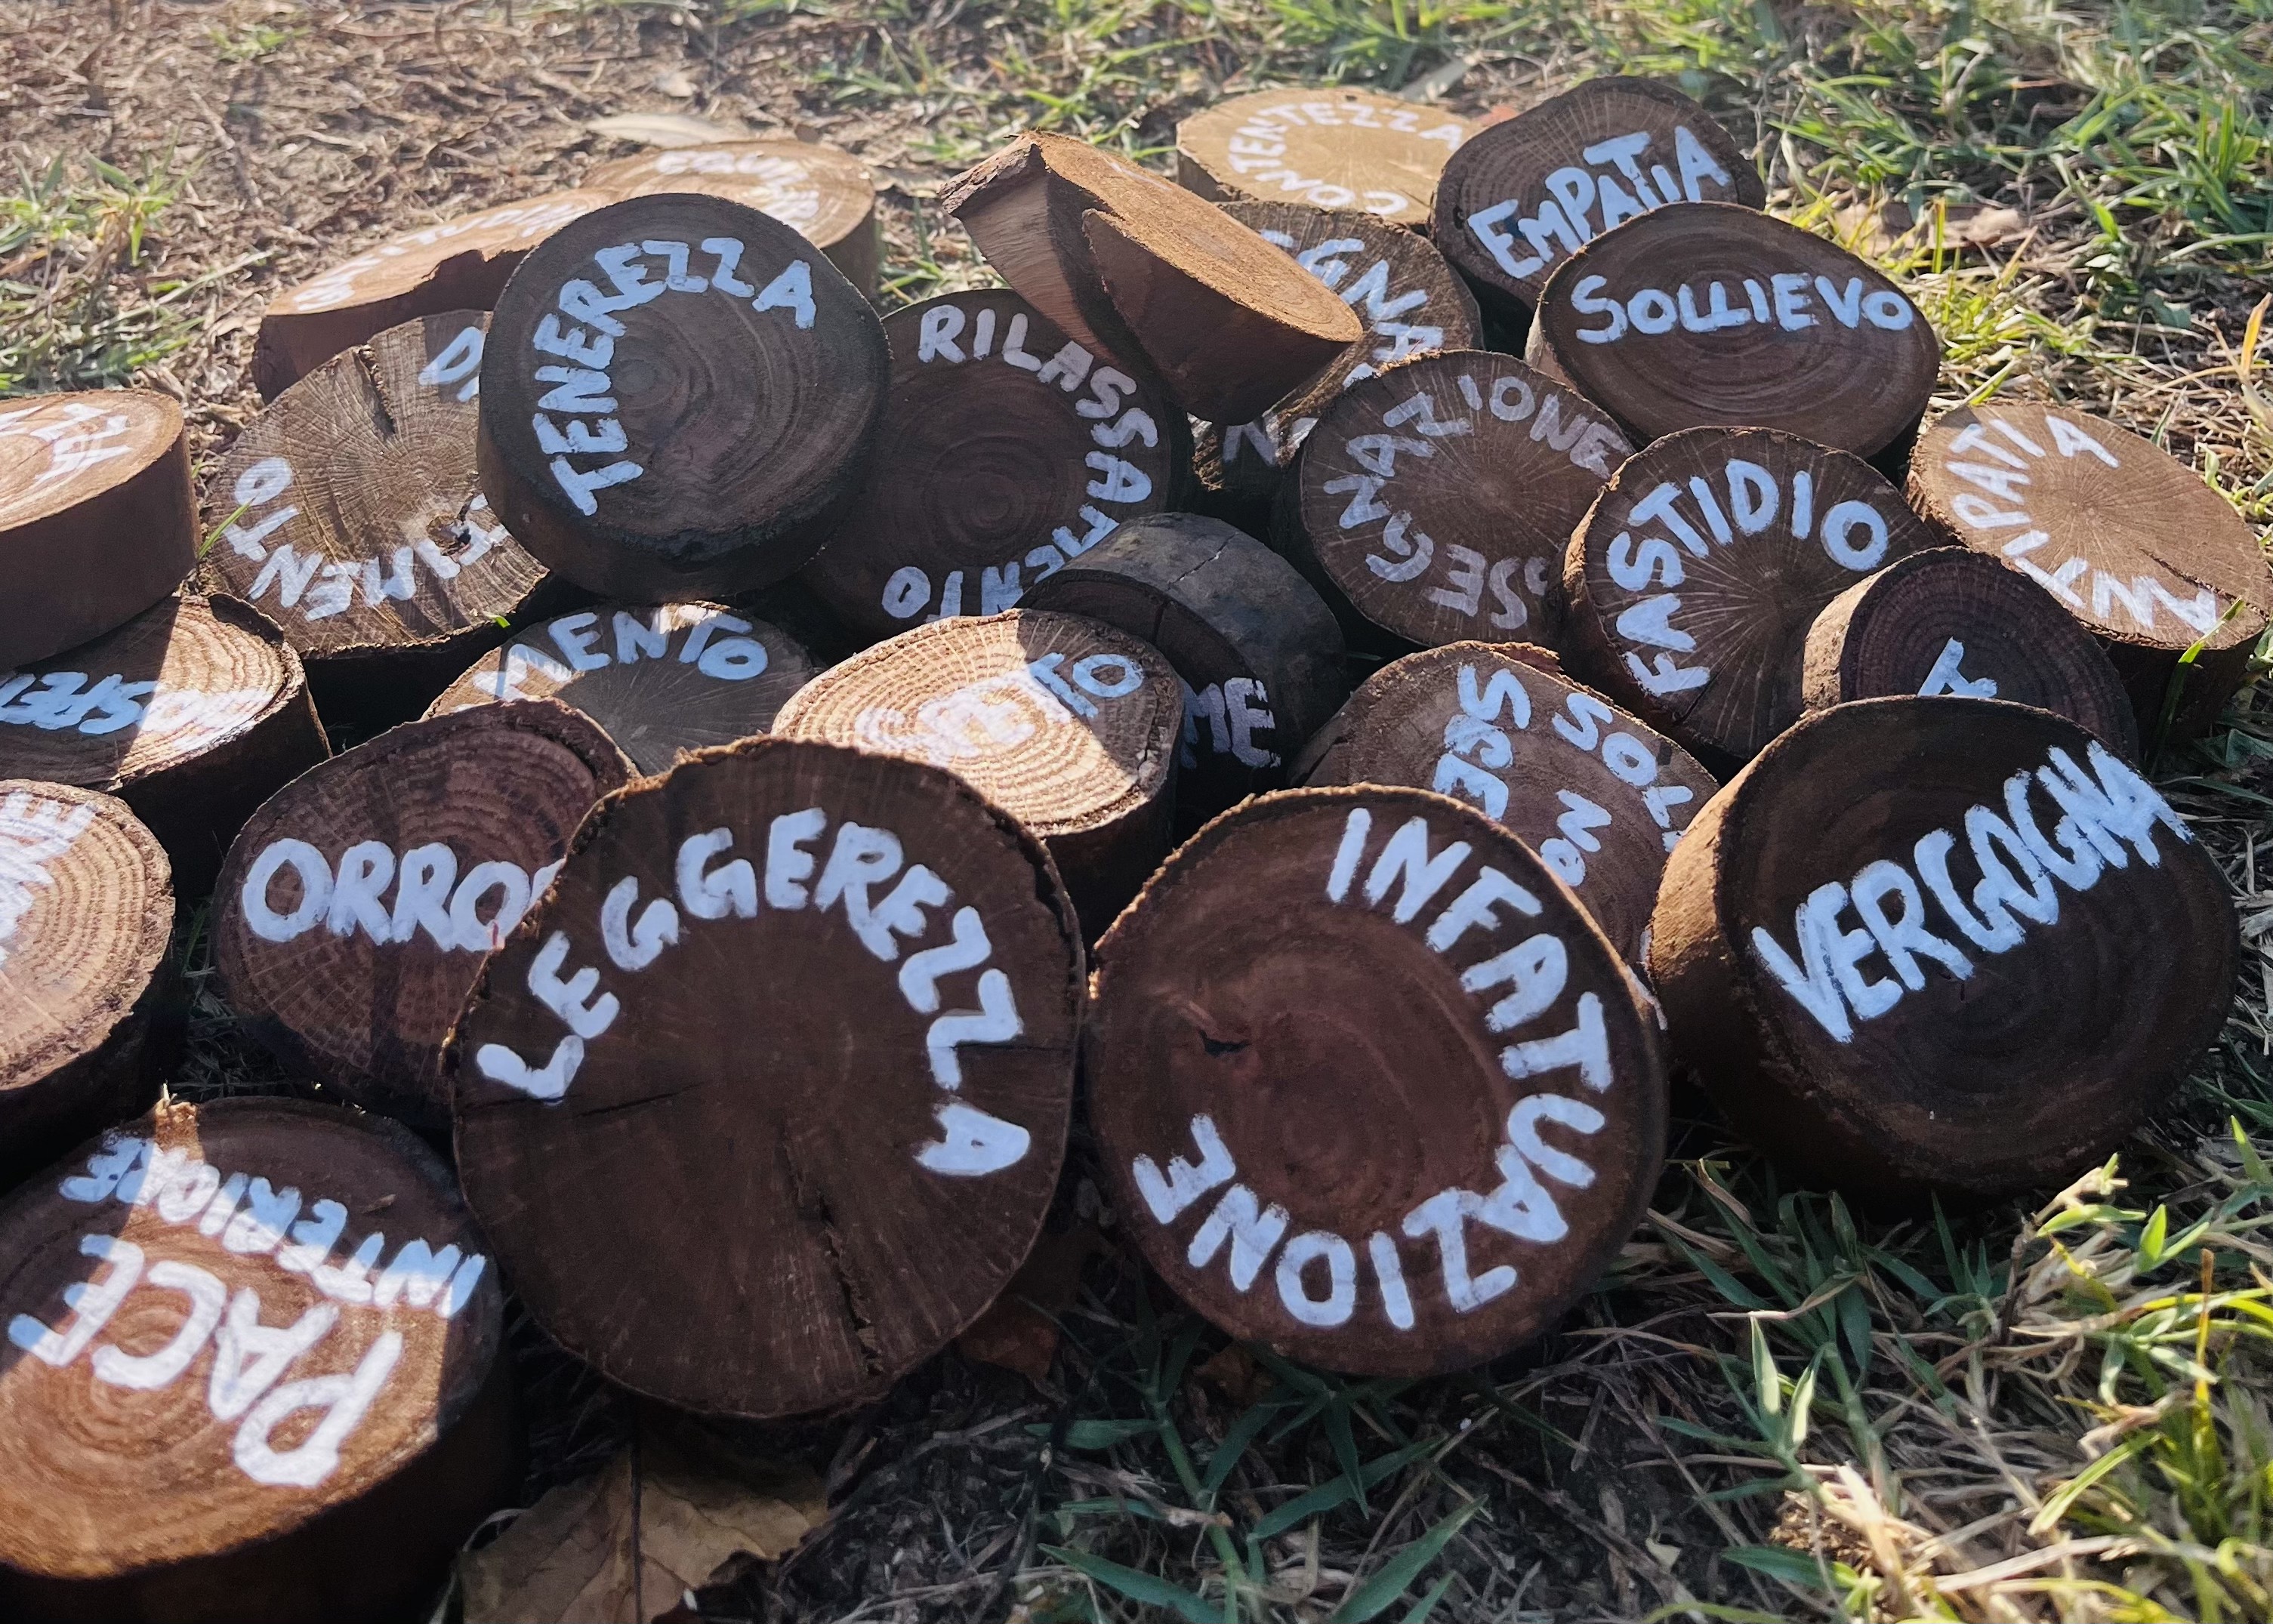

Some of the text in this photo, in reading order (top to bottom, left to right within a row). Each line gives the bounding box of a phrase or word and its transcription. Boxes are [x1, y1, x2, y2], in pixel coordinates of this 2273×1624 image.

[1228, 101, 1463, 215] CONTENTEZZA
[1467, 125, 1732, 278] EMPATIA
[531, 237, 817, 516] TENEREZZA
[1571, 273, 1913, 344] SOLLIEVO
[1606, 458, 1889, 698] FASTIDIO
[1946, 415, 2216, 633] ANTIPATIA
[464, 604, 769, 705] MENTO
[242, 837, 566, 952] ORRO
[477, 808, 1031, 1176] LEGGEREZZA
[1750, 739, 2196, 1043] VERGOGNA
[1133, 807, 1614, 1330] INFATUAZIONE
[8, 1234, 403, 1487] PACE
